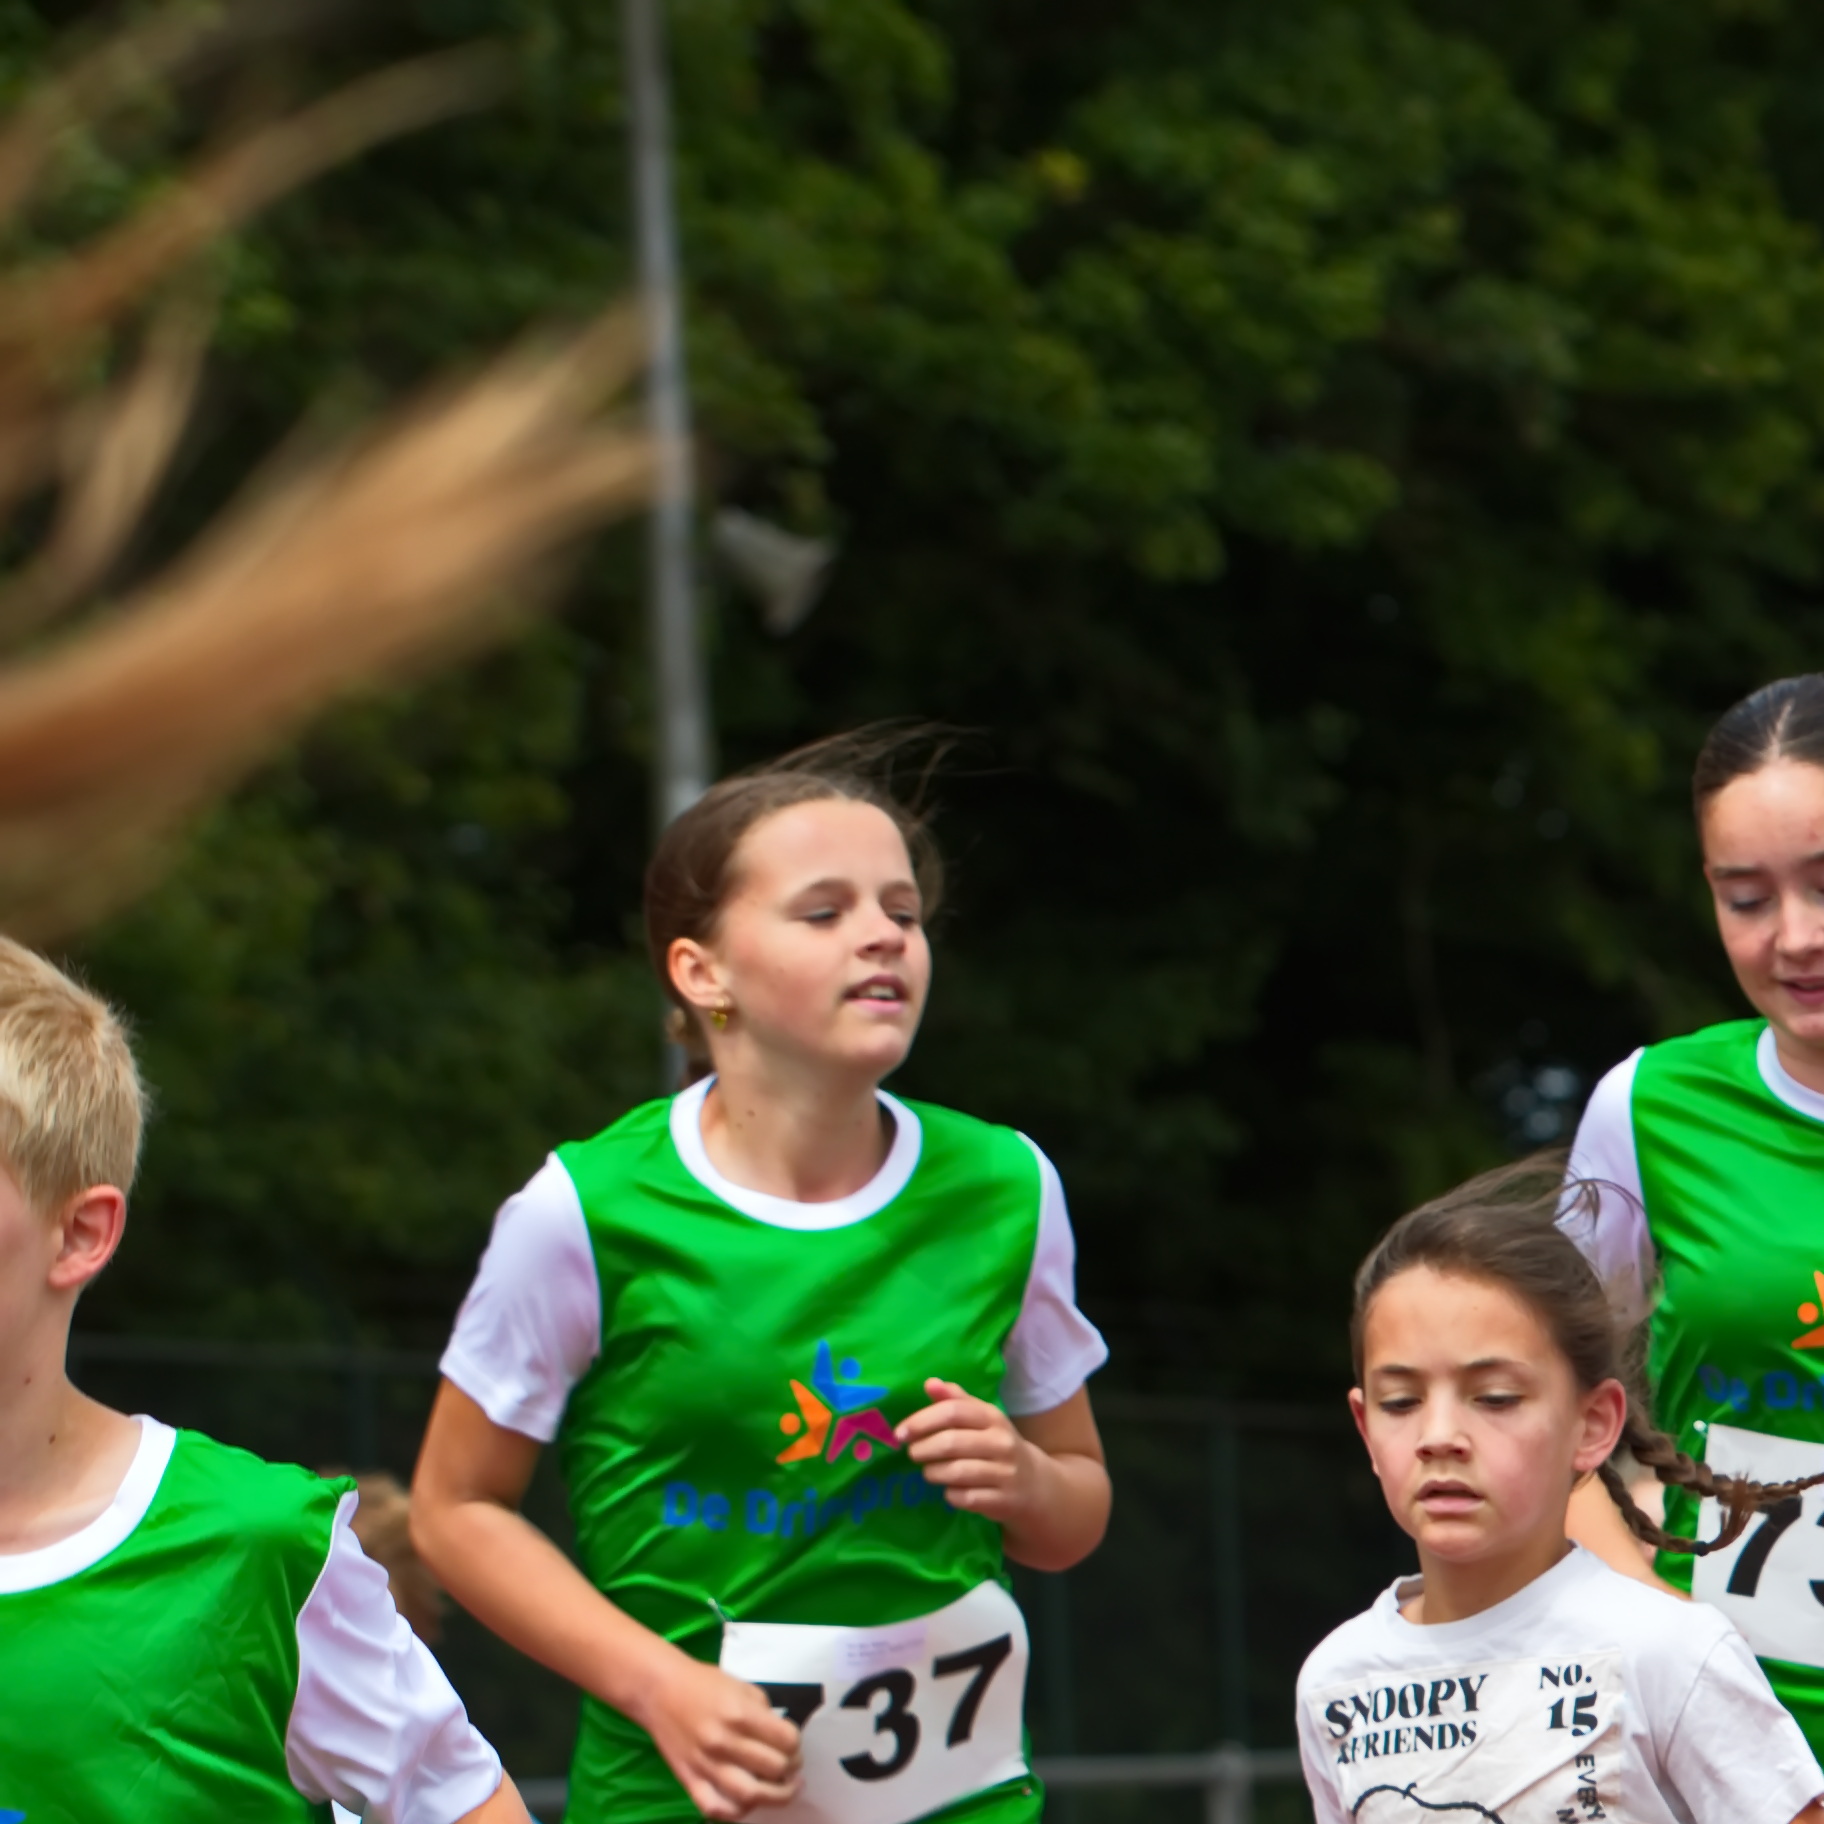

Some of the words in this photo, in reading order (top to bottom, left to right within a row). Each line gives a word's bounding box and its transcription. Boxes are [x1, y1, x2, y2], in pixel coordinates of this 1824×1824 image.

[664, 1480, 731, 1532] De
[1539, 1663, 1593, 1690] NO.
[1325, 1673, 1490, 1740] SNOOPY
[1546, 1690, 1599, 1737] 15
